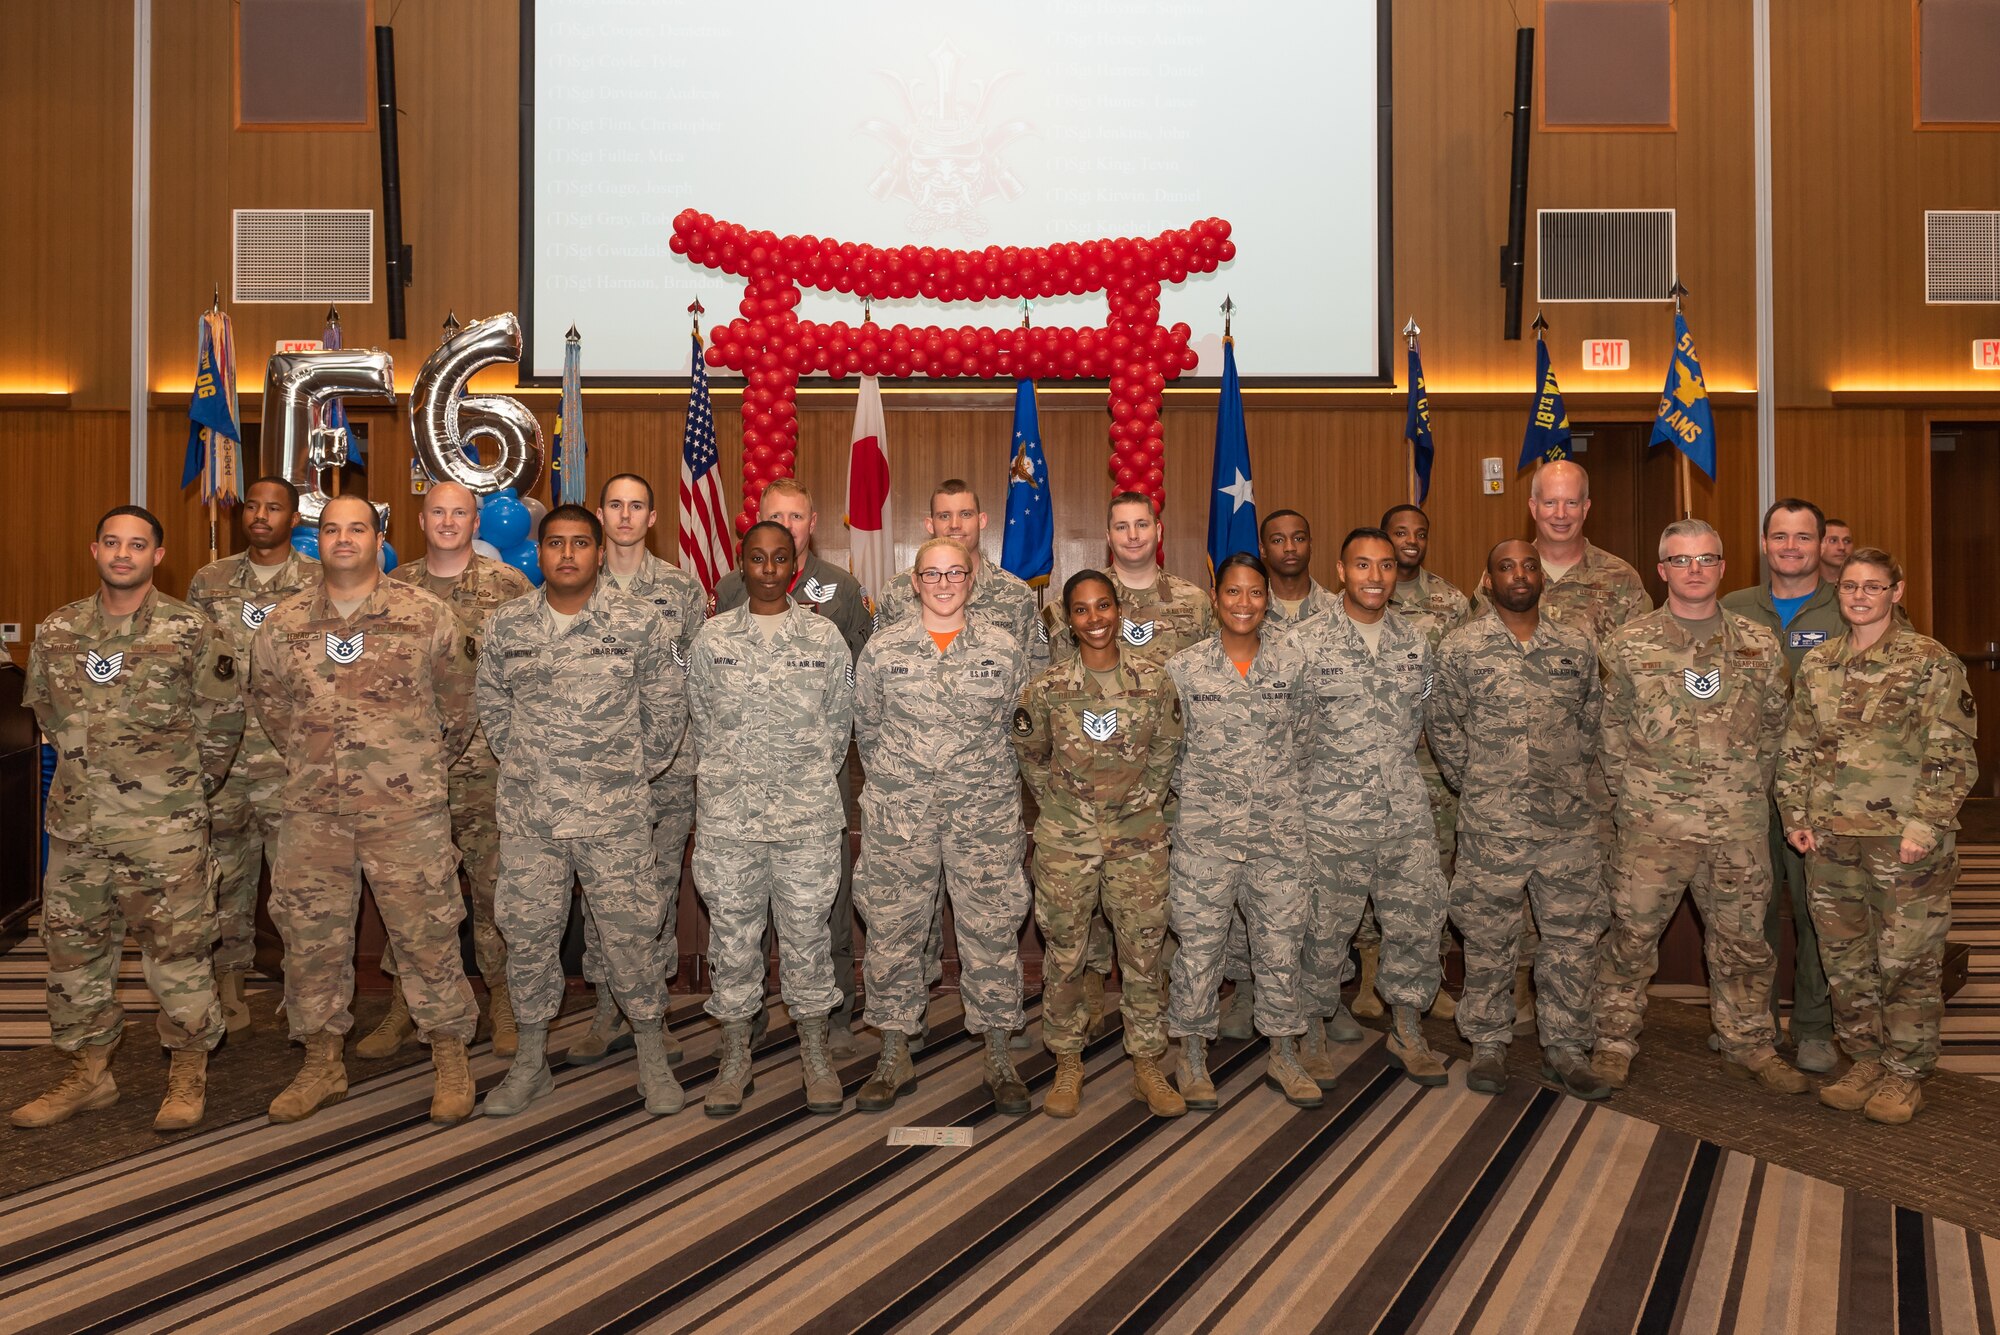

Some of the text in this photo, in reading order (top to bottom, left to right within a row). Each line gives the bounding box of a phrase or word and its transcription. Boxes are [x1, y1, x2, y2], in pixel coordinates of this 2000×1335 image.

[651, 54, 687, 71] Tyler
[1159, 63, 1206, 77] Daniel
[548, 117, 594, 134] (T)Sgt
[640, 117, 722, 134] Christopher
[1158, 125, 1191, 140] John
[547, 149, 685, 165] (T)Sgt Fuller, Mica
[1046, 156, 1091, 173] (T)Sgt
[1096, 156, 1136, 173] King,
[547, 180, 593, 197] (T)Sgt
[644, 180, 693, 197] Joseph
[1046, 188, 1091, 205] (T)Sgt
[1154, 188, 1201, 202] Daniel
[547, 212, 674, 228] (T)Sgt Gray, Rob
[546, 243, 669, 260] (T)Sgt Gwuzdals
[546, 275, 592, 291] (T)Sgt
[597, 275, 660, 290] Harmon,
[1592, 342, 1624, 366] EXIT
[196, 373, 217, 399] OG
[1534, 396, 1556, 430] 18TH
[1665, 409, 1703, 443] AMS
[661, 609, 677, 618] FORCE
[611, 647, 628, 655] FORCE
[970, 670, 979, 678] U.S.
[980, 670, 990, 678] AIR
[1321, 667, 1344, 676] REYES
[1474, 668, 1496, 676] COOPER
